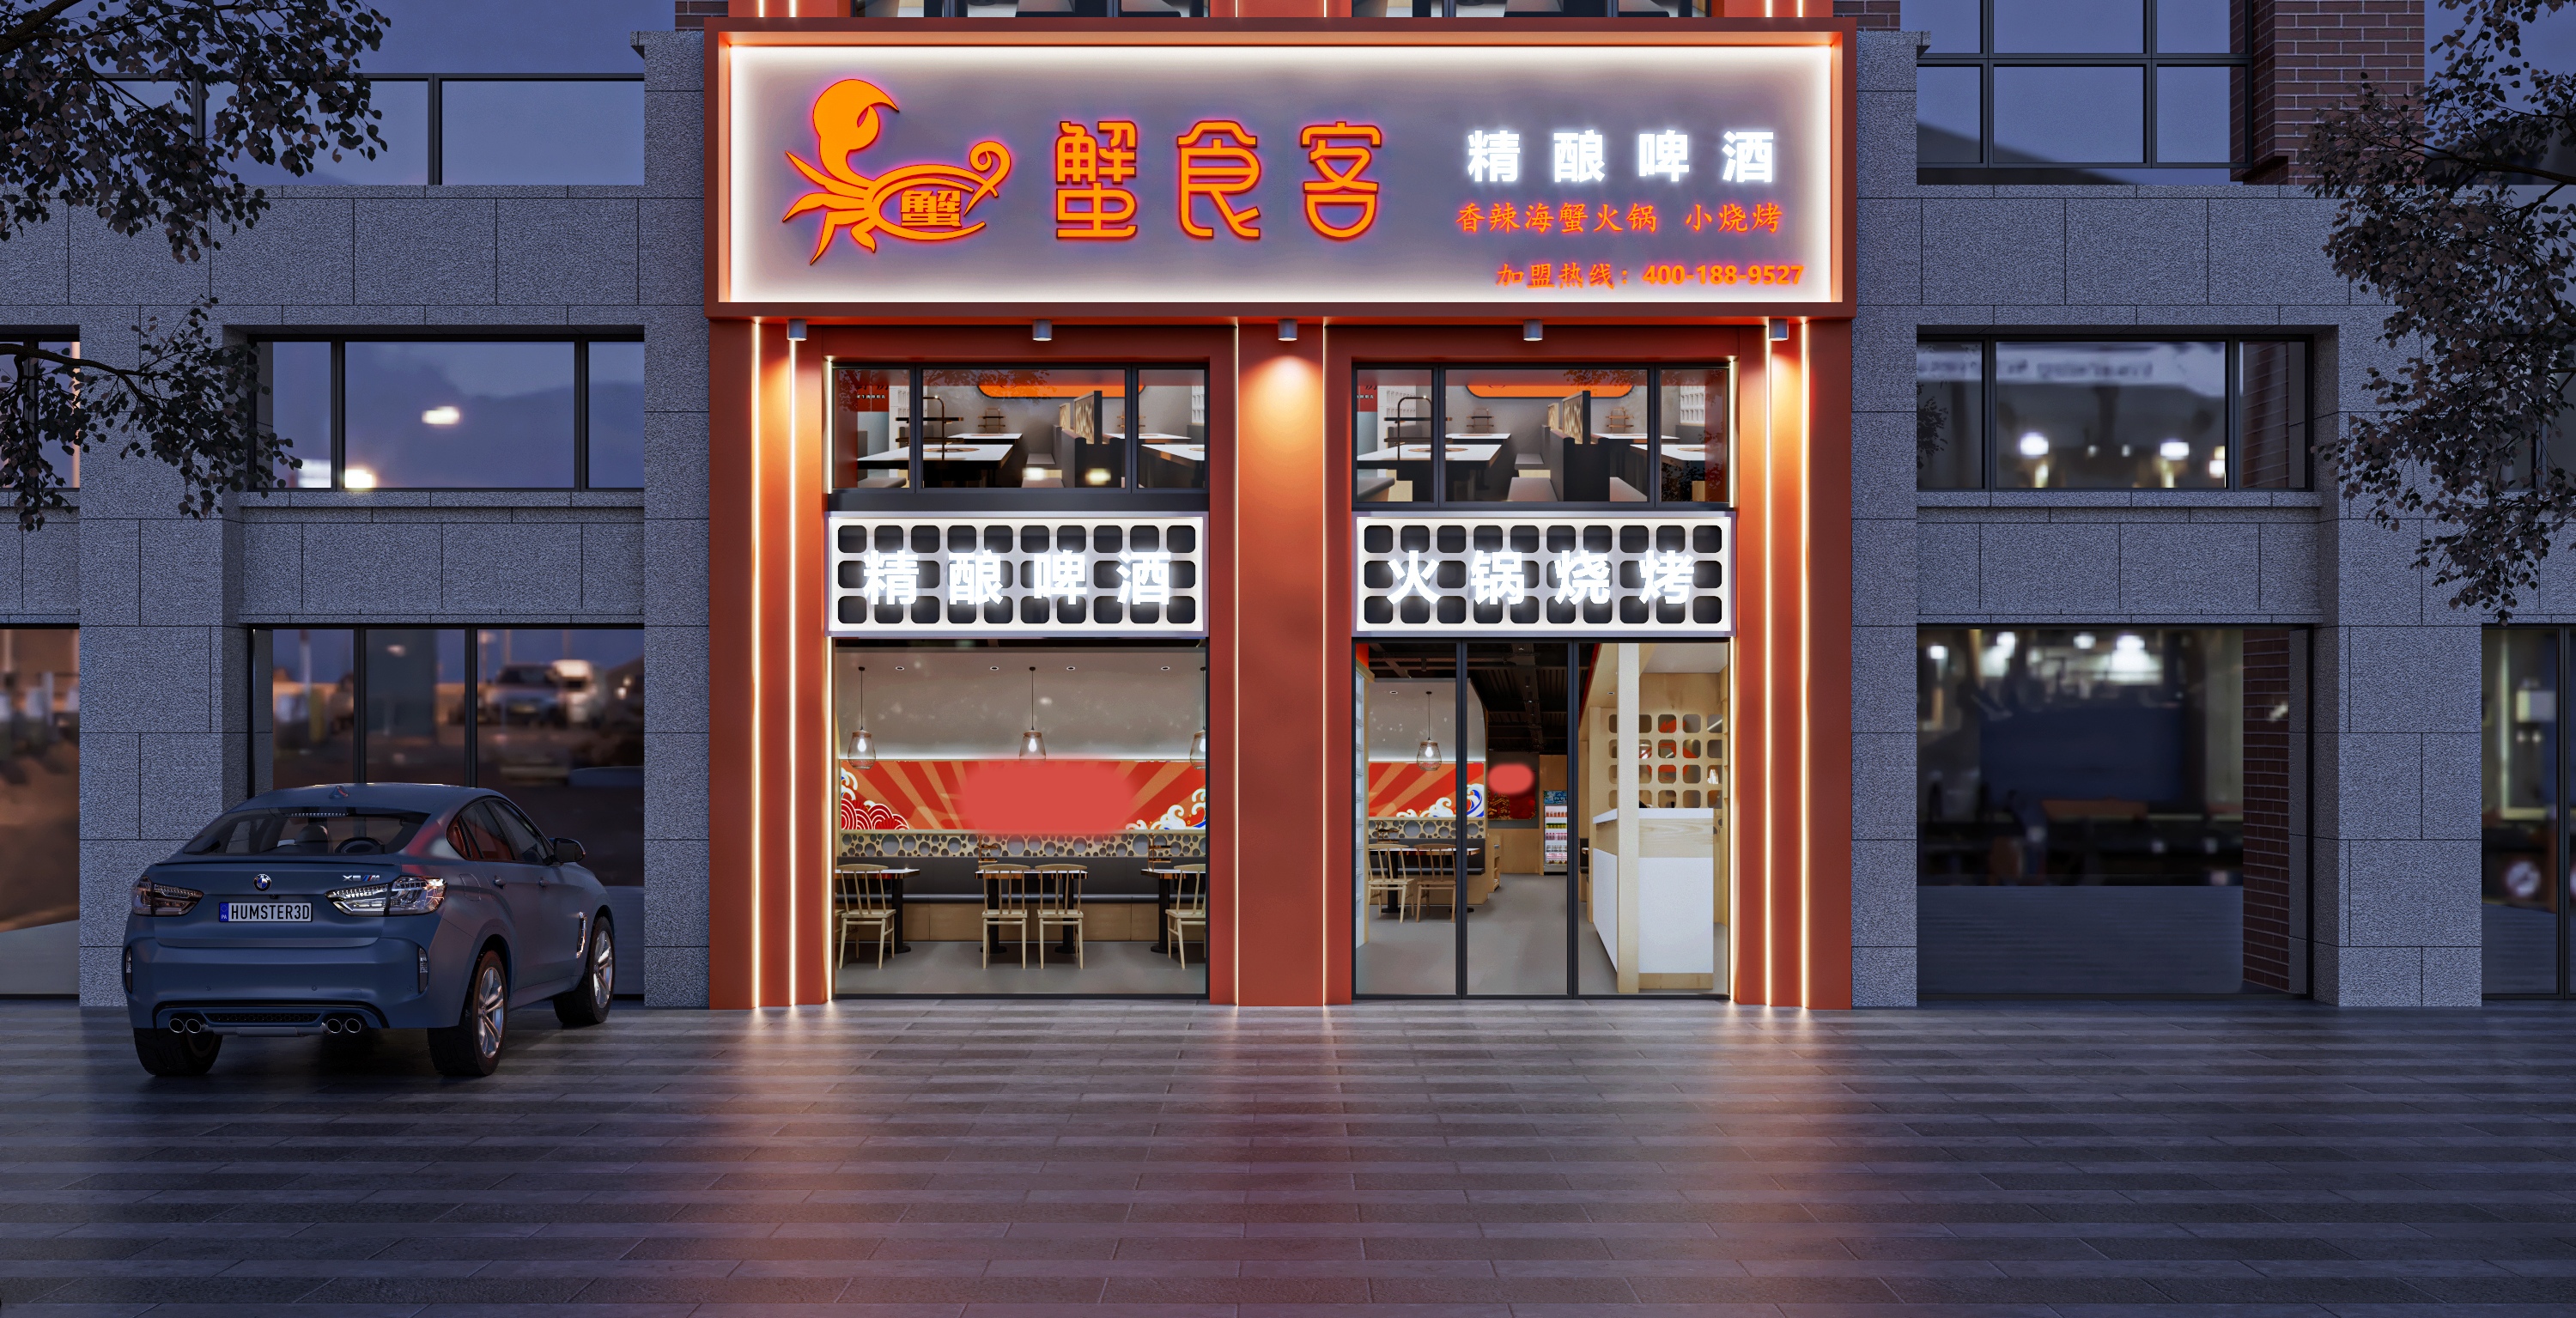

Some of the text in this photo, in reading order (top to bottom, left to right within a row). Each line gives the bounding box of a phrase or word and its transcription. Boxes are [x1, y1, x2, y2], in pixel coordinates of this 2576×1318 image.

[1055, 120, 1382, 240] 蟹食客
[1467, 129, 1775, 183] 精酿啤酒
[899, 190, 963, 228] 蟹
[1455, 202, 1783, 234] 香辣海蟹火锅 小烧烤
[862, 549, 1172, 606] 精酿啤酒
[1386, 549, 1696, 606] 火锅烧烤
[231, 904, 310, 920] HUMSTER3D
